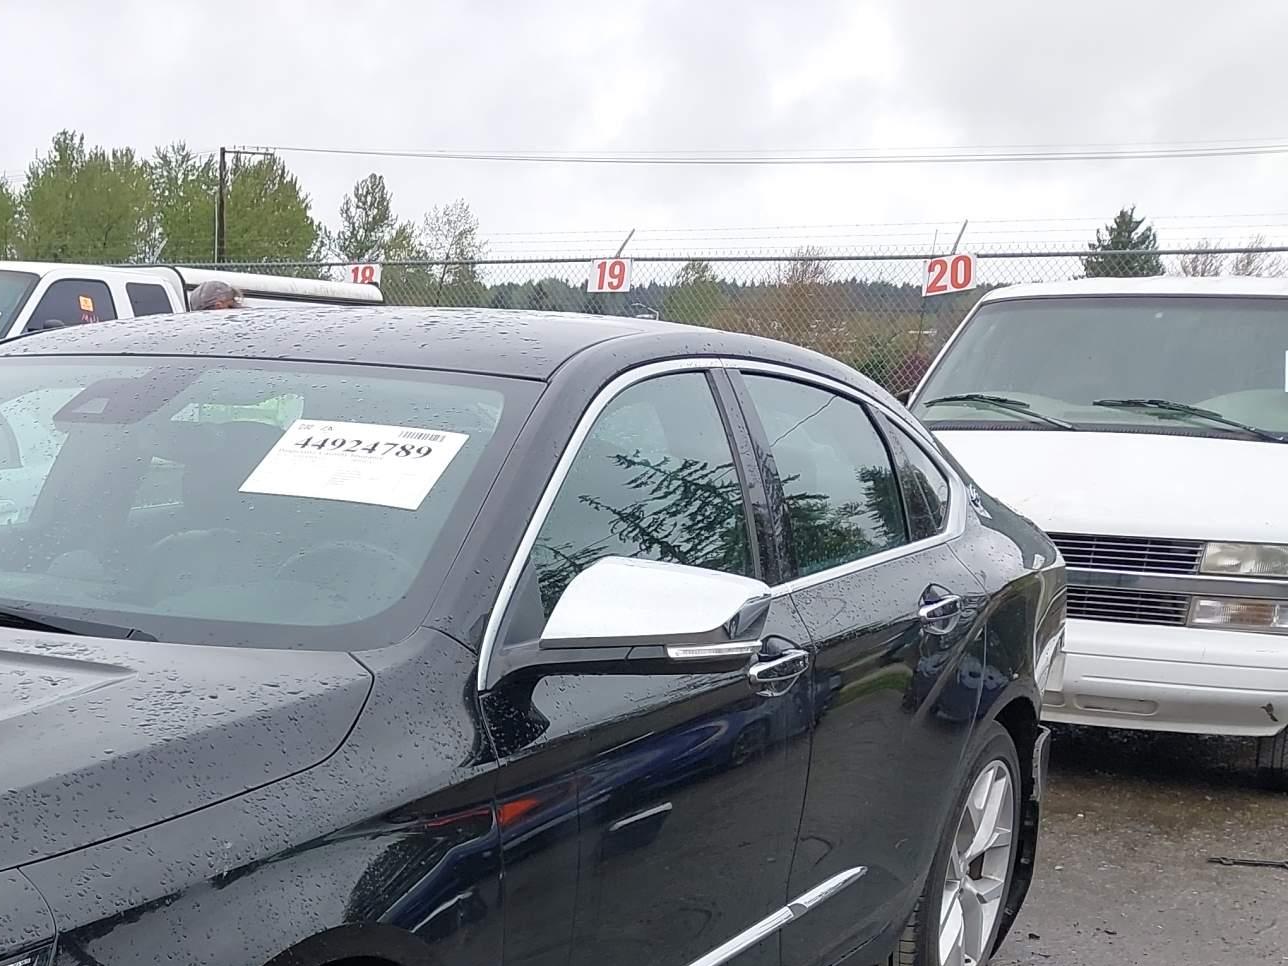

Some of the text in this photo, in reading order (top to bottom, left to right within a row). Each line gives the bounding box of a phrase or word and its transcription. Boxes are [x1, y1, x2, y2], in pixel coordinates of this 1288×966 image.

[597, 260, 626, 291] 19
[926, 255, 972, 294] 20
[294, 435, 433, 460] 44924789
